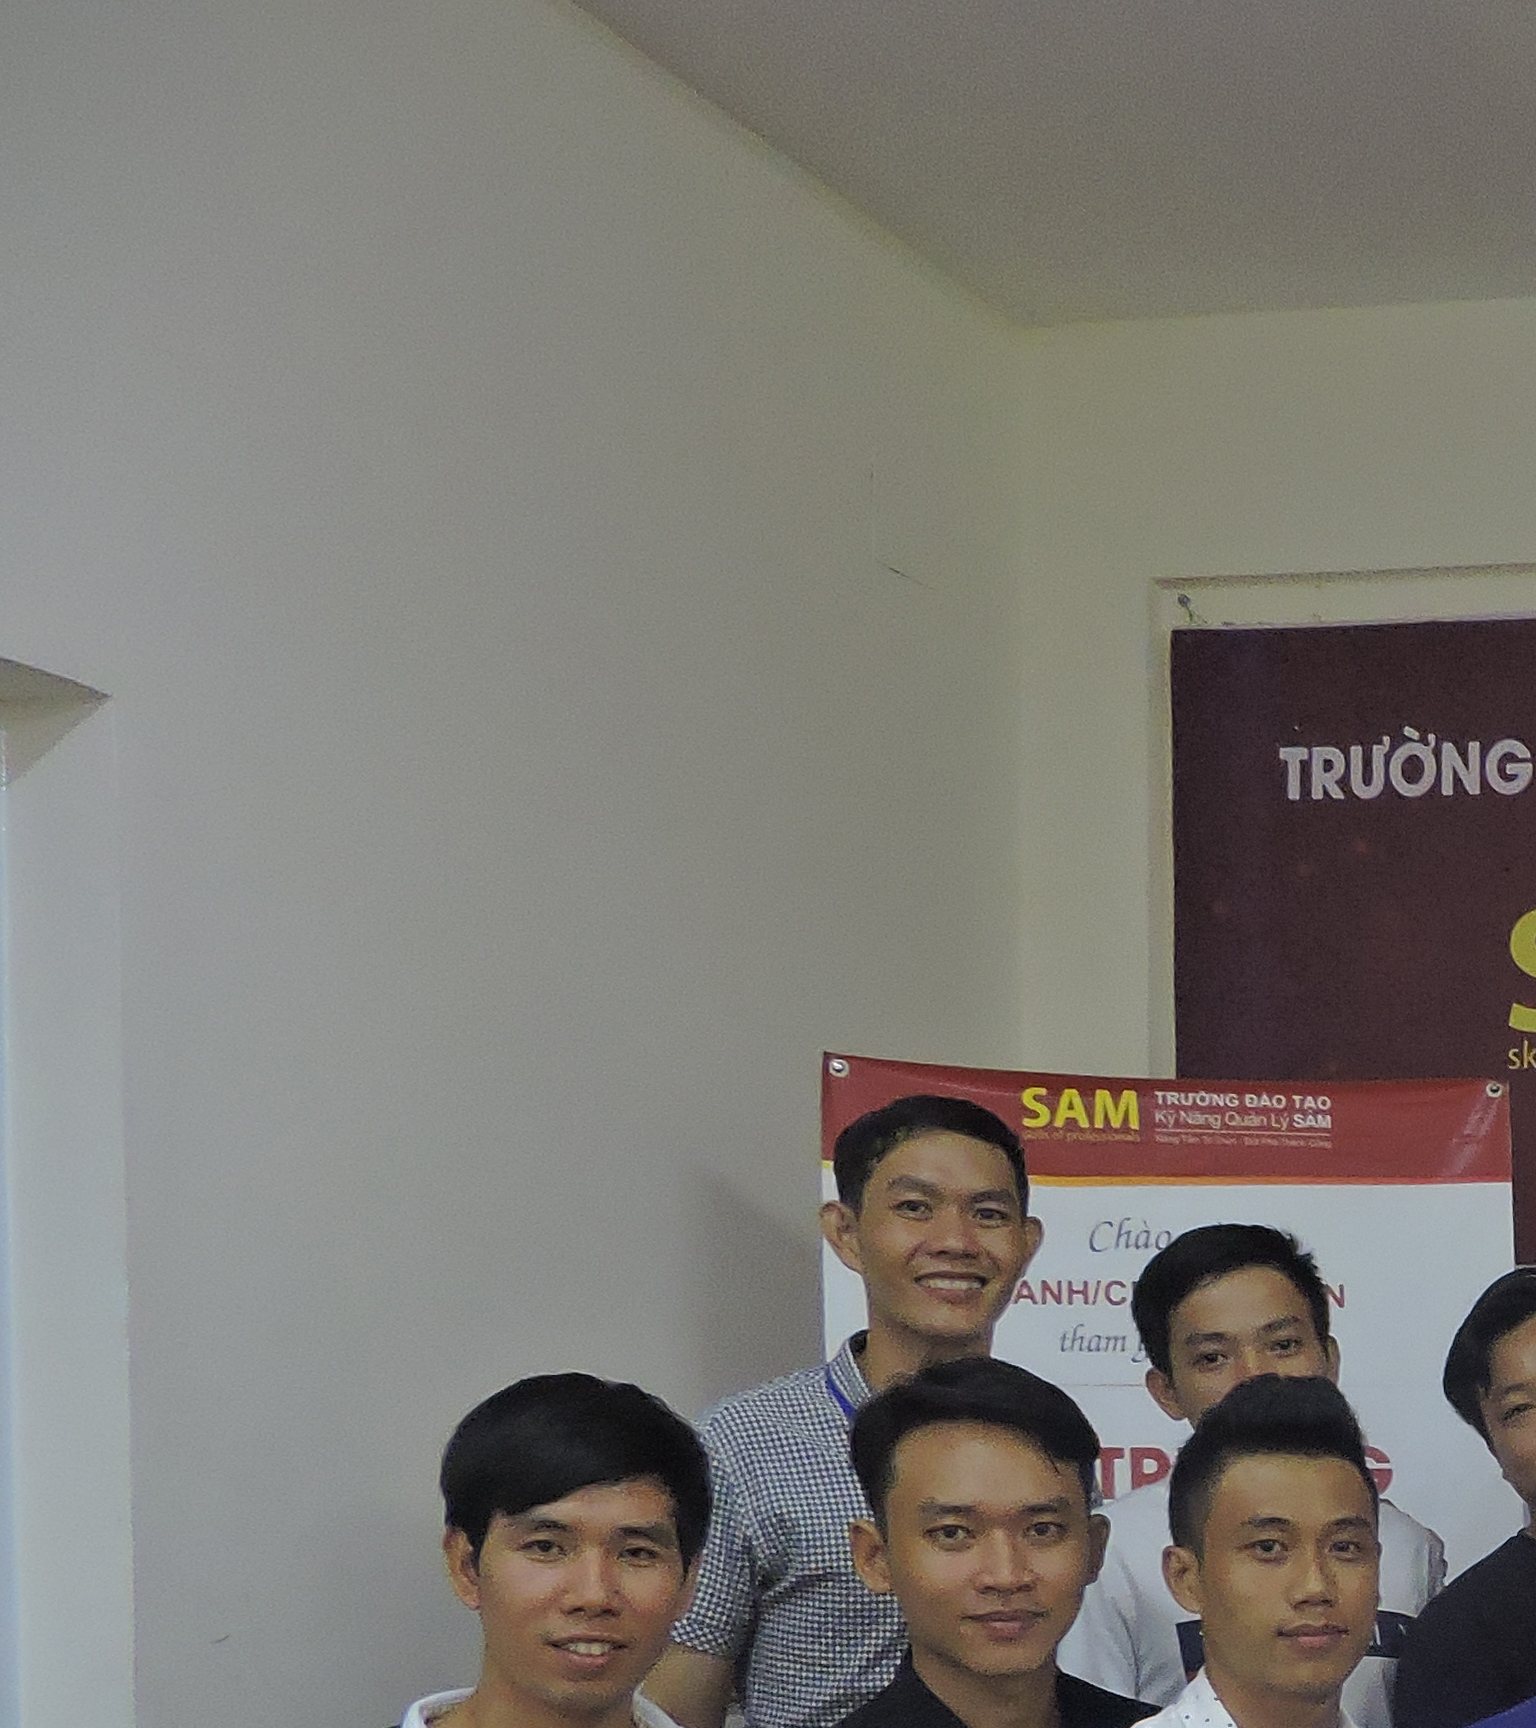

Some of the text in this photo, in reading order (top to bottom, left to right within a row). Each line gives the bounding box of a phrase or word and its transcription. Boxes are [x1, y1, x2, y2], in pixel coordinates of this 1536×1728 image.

[1279, 726, 1533, 800] TRƯỜNG
[1022, 1087, 1140, 1131] SAM
[1088, 1218, 1173, 1253] Chào
[1060, 1323, 1127, 1353] tham
